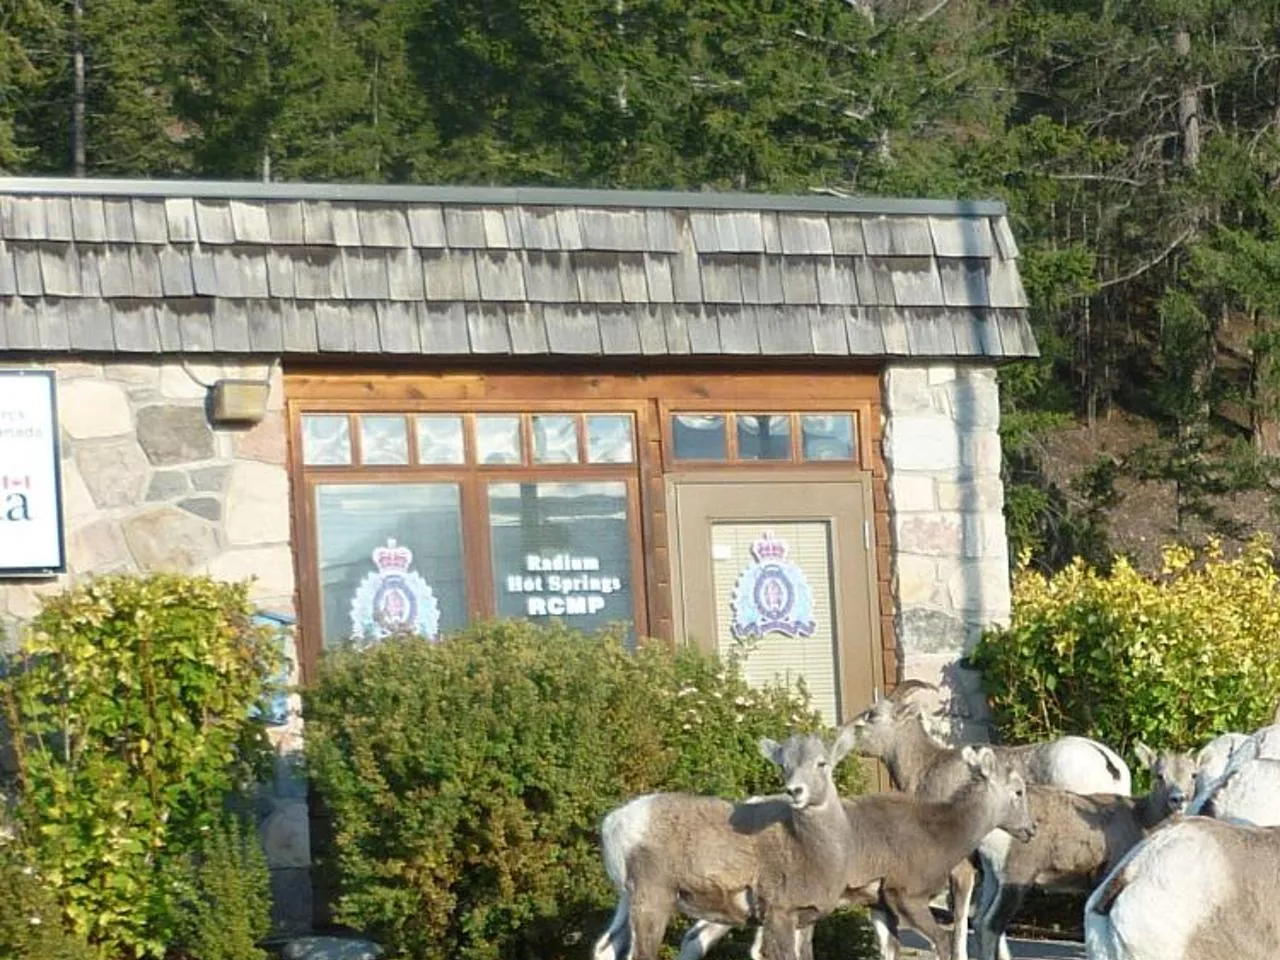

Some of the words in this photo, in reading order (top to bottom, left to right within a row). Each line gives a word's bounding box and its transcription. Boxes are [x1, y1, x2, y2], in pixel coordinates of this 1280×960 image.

[526, 554, 600, 571] Radium
[507, 575, 543, 592] Hot
[548, 574, 621, 595] Springs
[528, 596, 605, 615] RCMP
